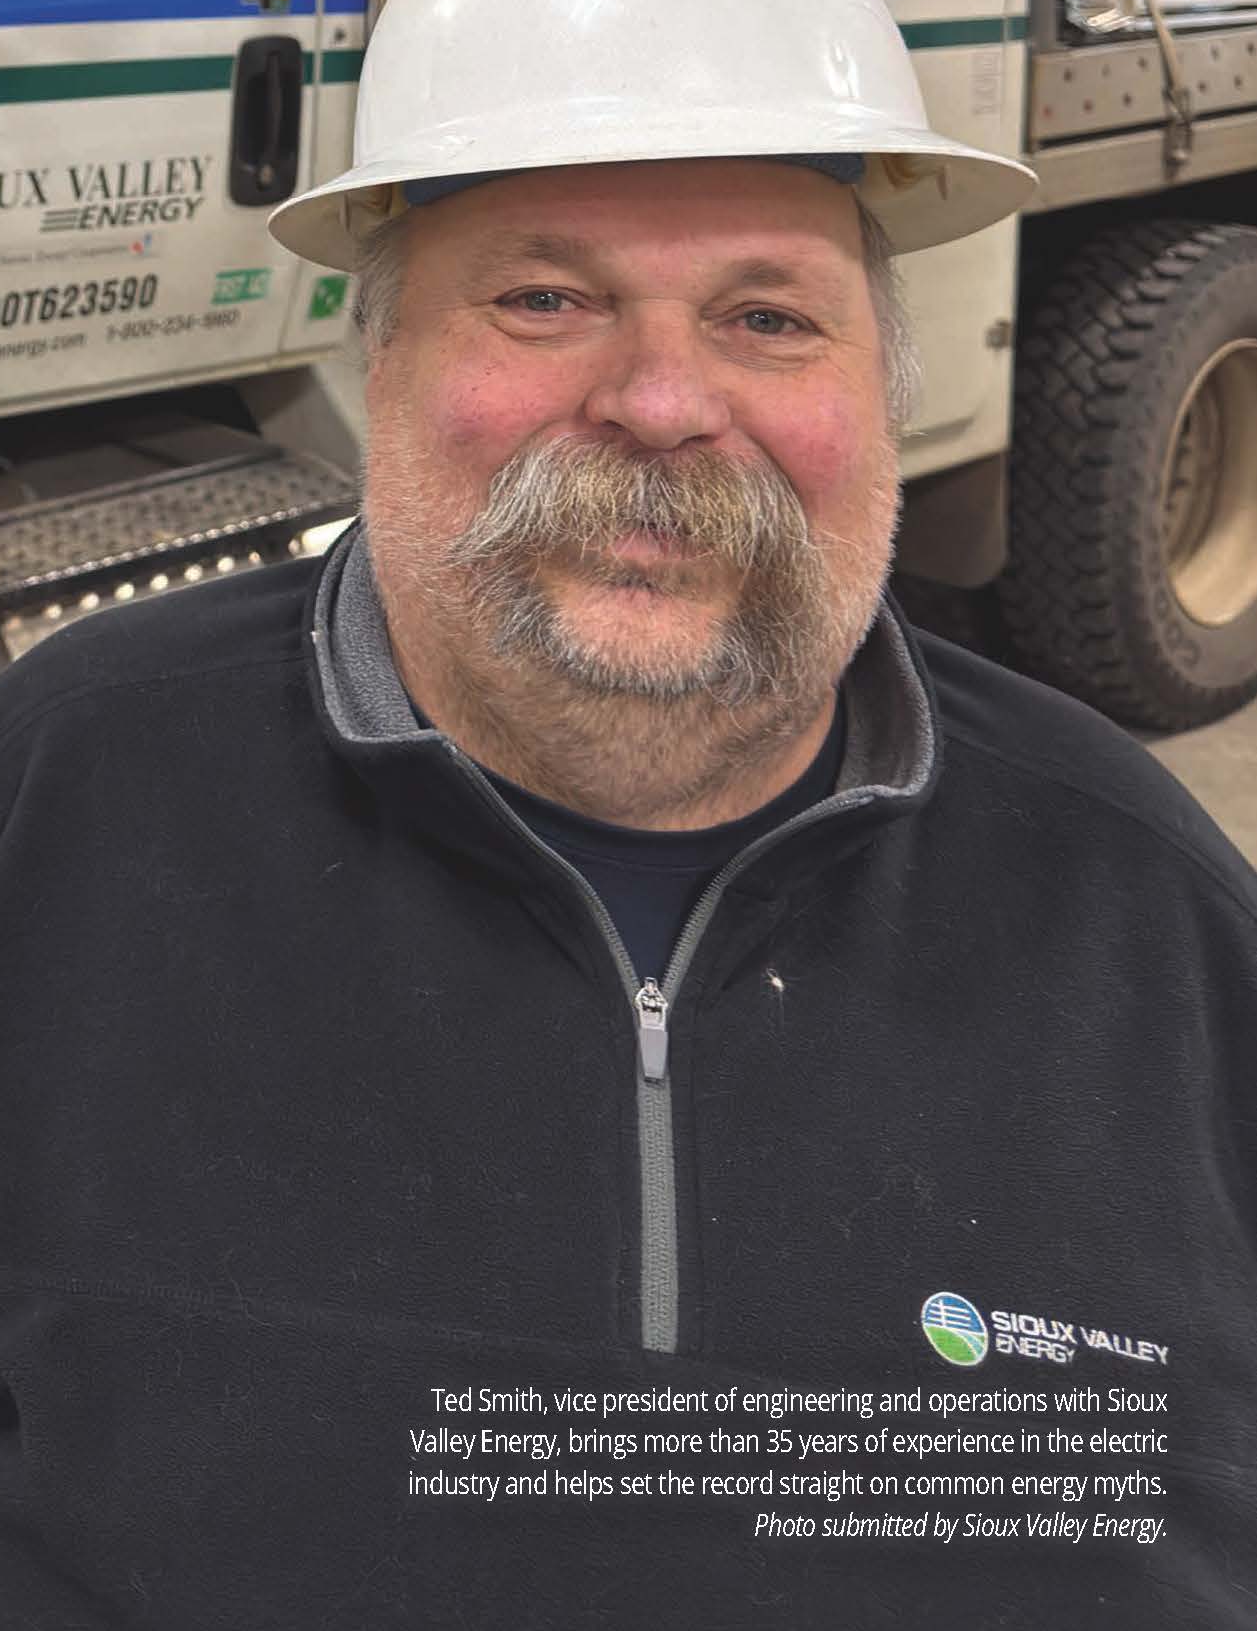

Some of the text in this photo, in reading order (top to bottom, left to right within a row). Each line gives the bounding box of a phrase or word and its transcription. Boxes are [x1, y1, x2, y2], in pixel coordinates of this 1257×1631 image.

[66, 155, 212, 203] VALLEY
[78, 197, 204, 230] ENERGY
[991, 1310, 1168, 1365] SIOUX VALLEY
[995, 1332, 1076, 1364] ENERGY
